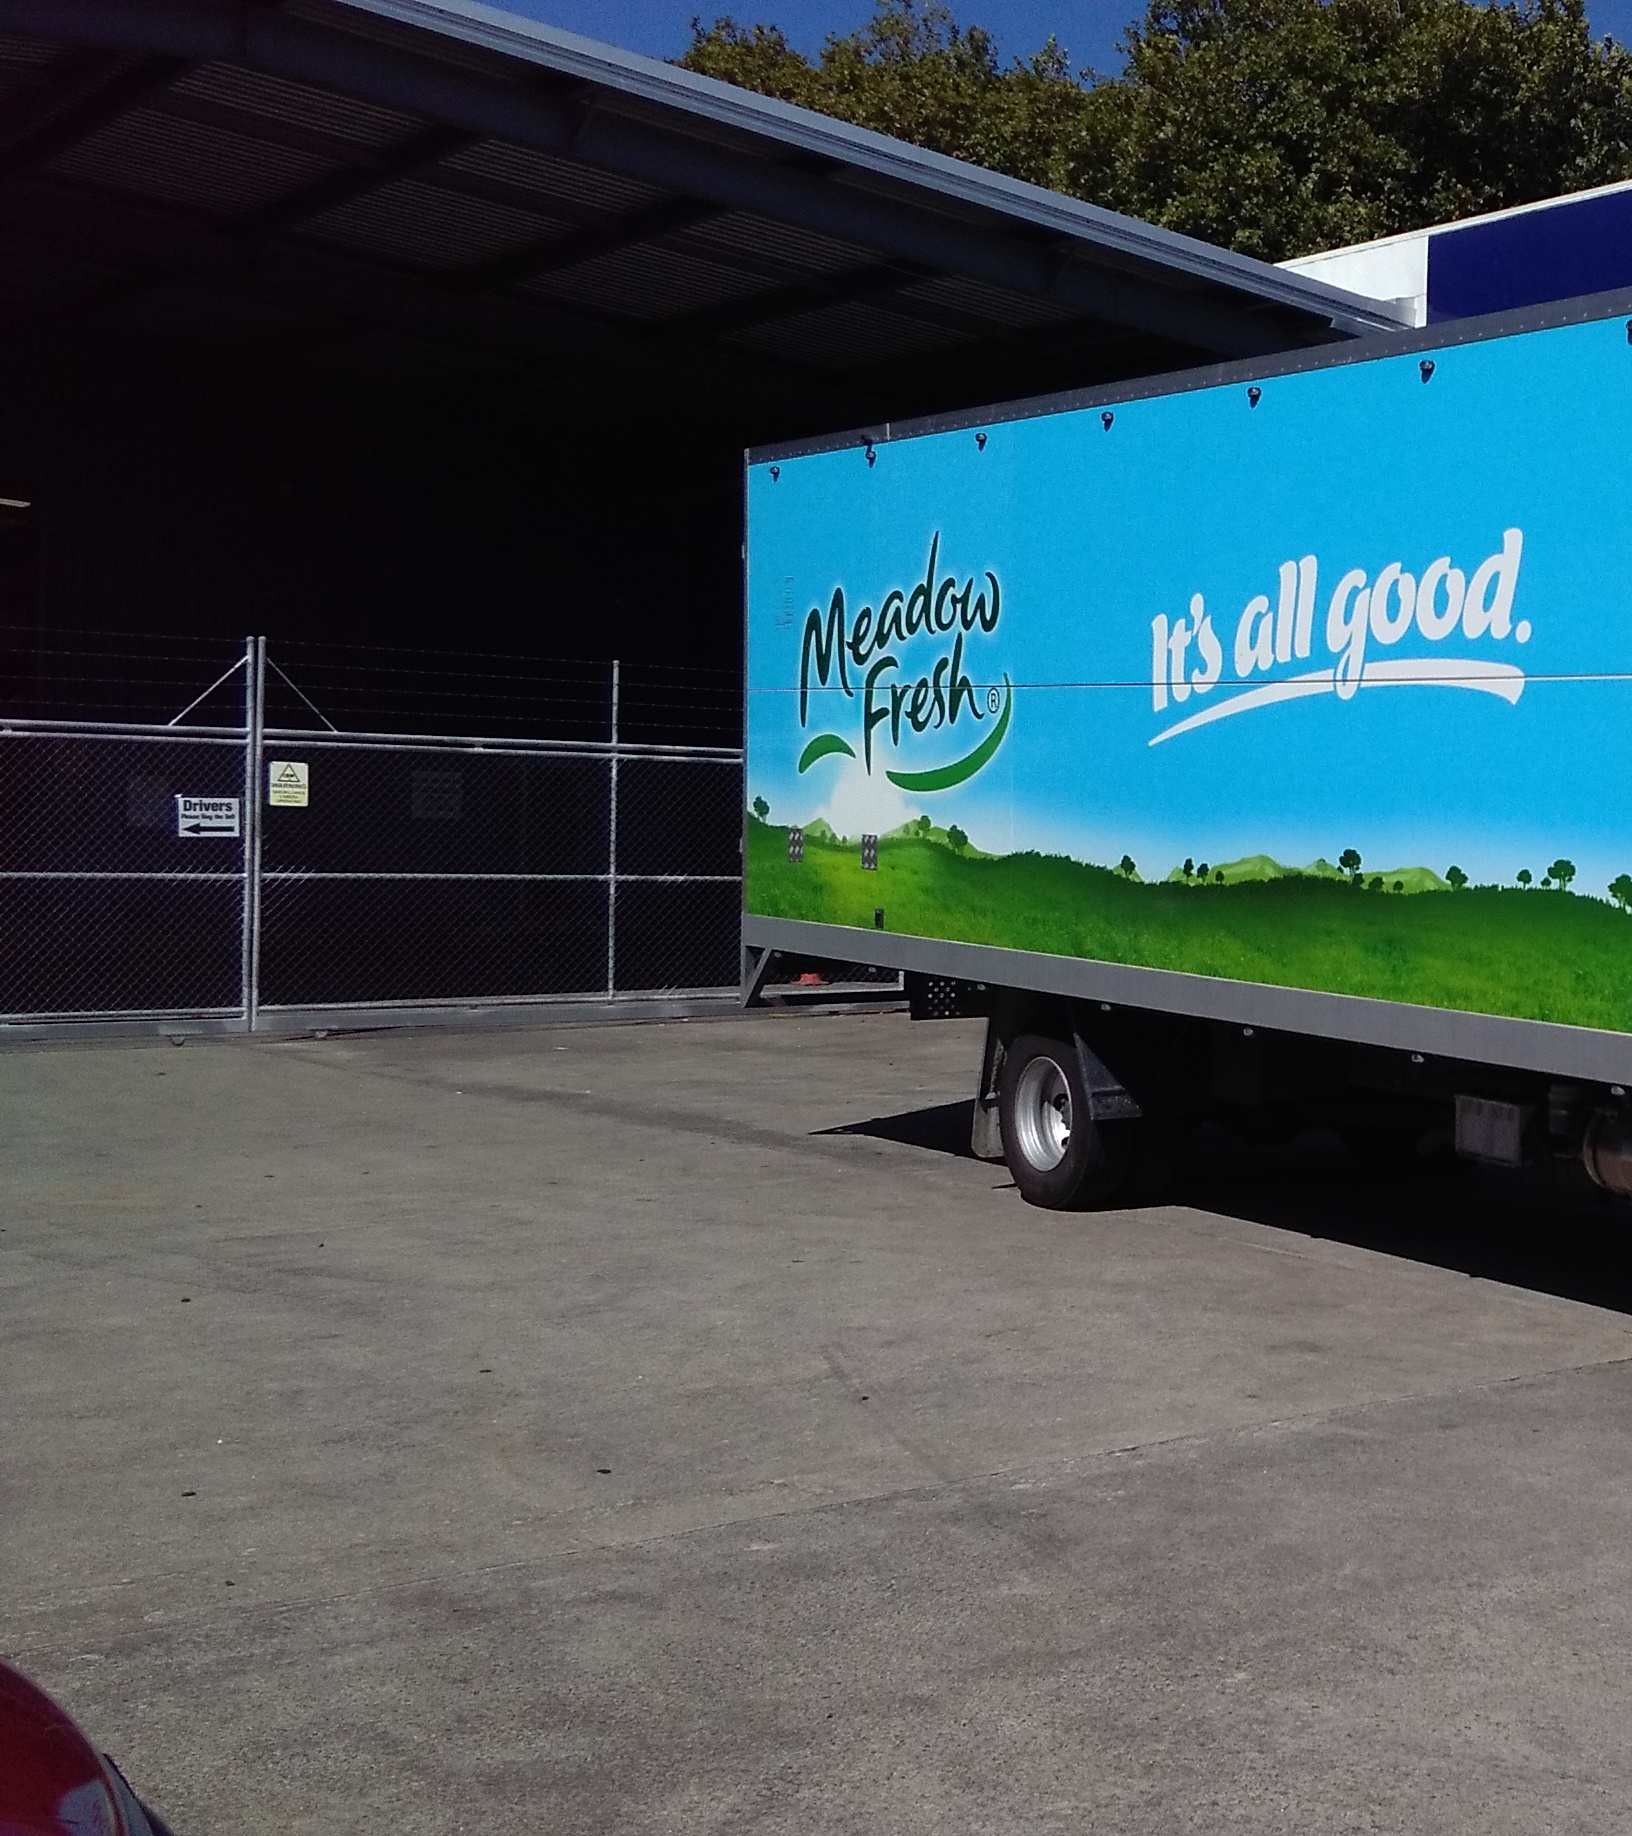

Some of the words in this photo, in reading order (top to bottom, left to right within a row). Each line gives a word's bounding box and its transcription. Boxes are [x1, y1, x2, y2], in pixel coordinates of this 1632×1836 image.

[801, 531, 1001, 728] Meadow
[1152, 593, 1223, 712] It's
[1234, 554, 1318, 678] all
[1326, 527, 1532, 700] good.
[864, 631, 985, 777] Fresh
[183, 799, 233, 812] Drivers
